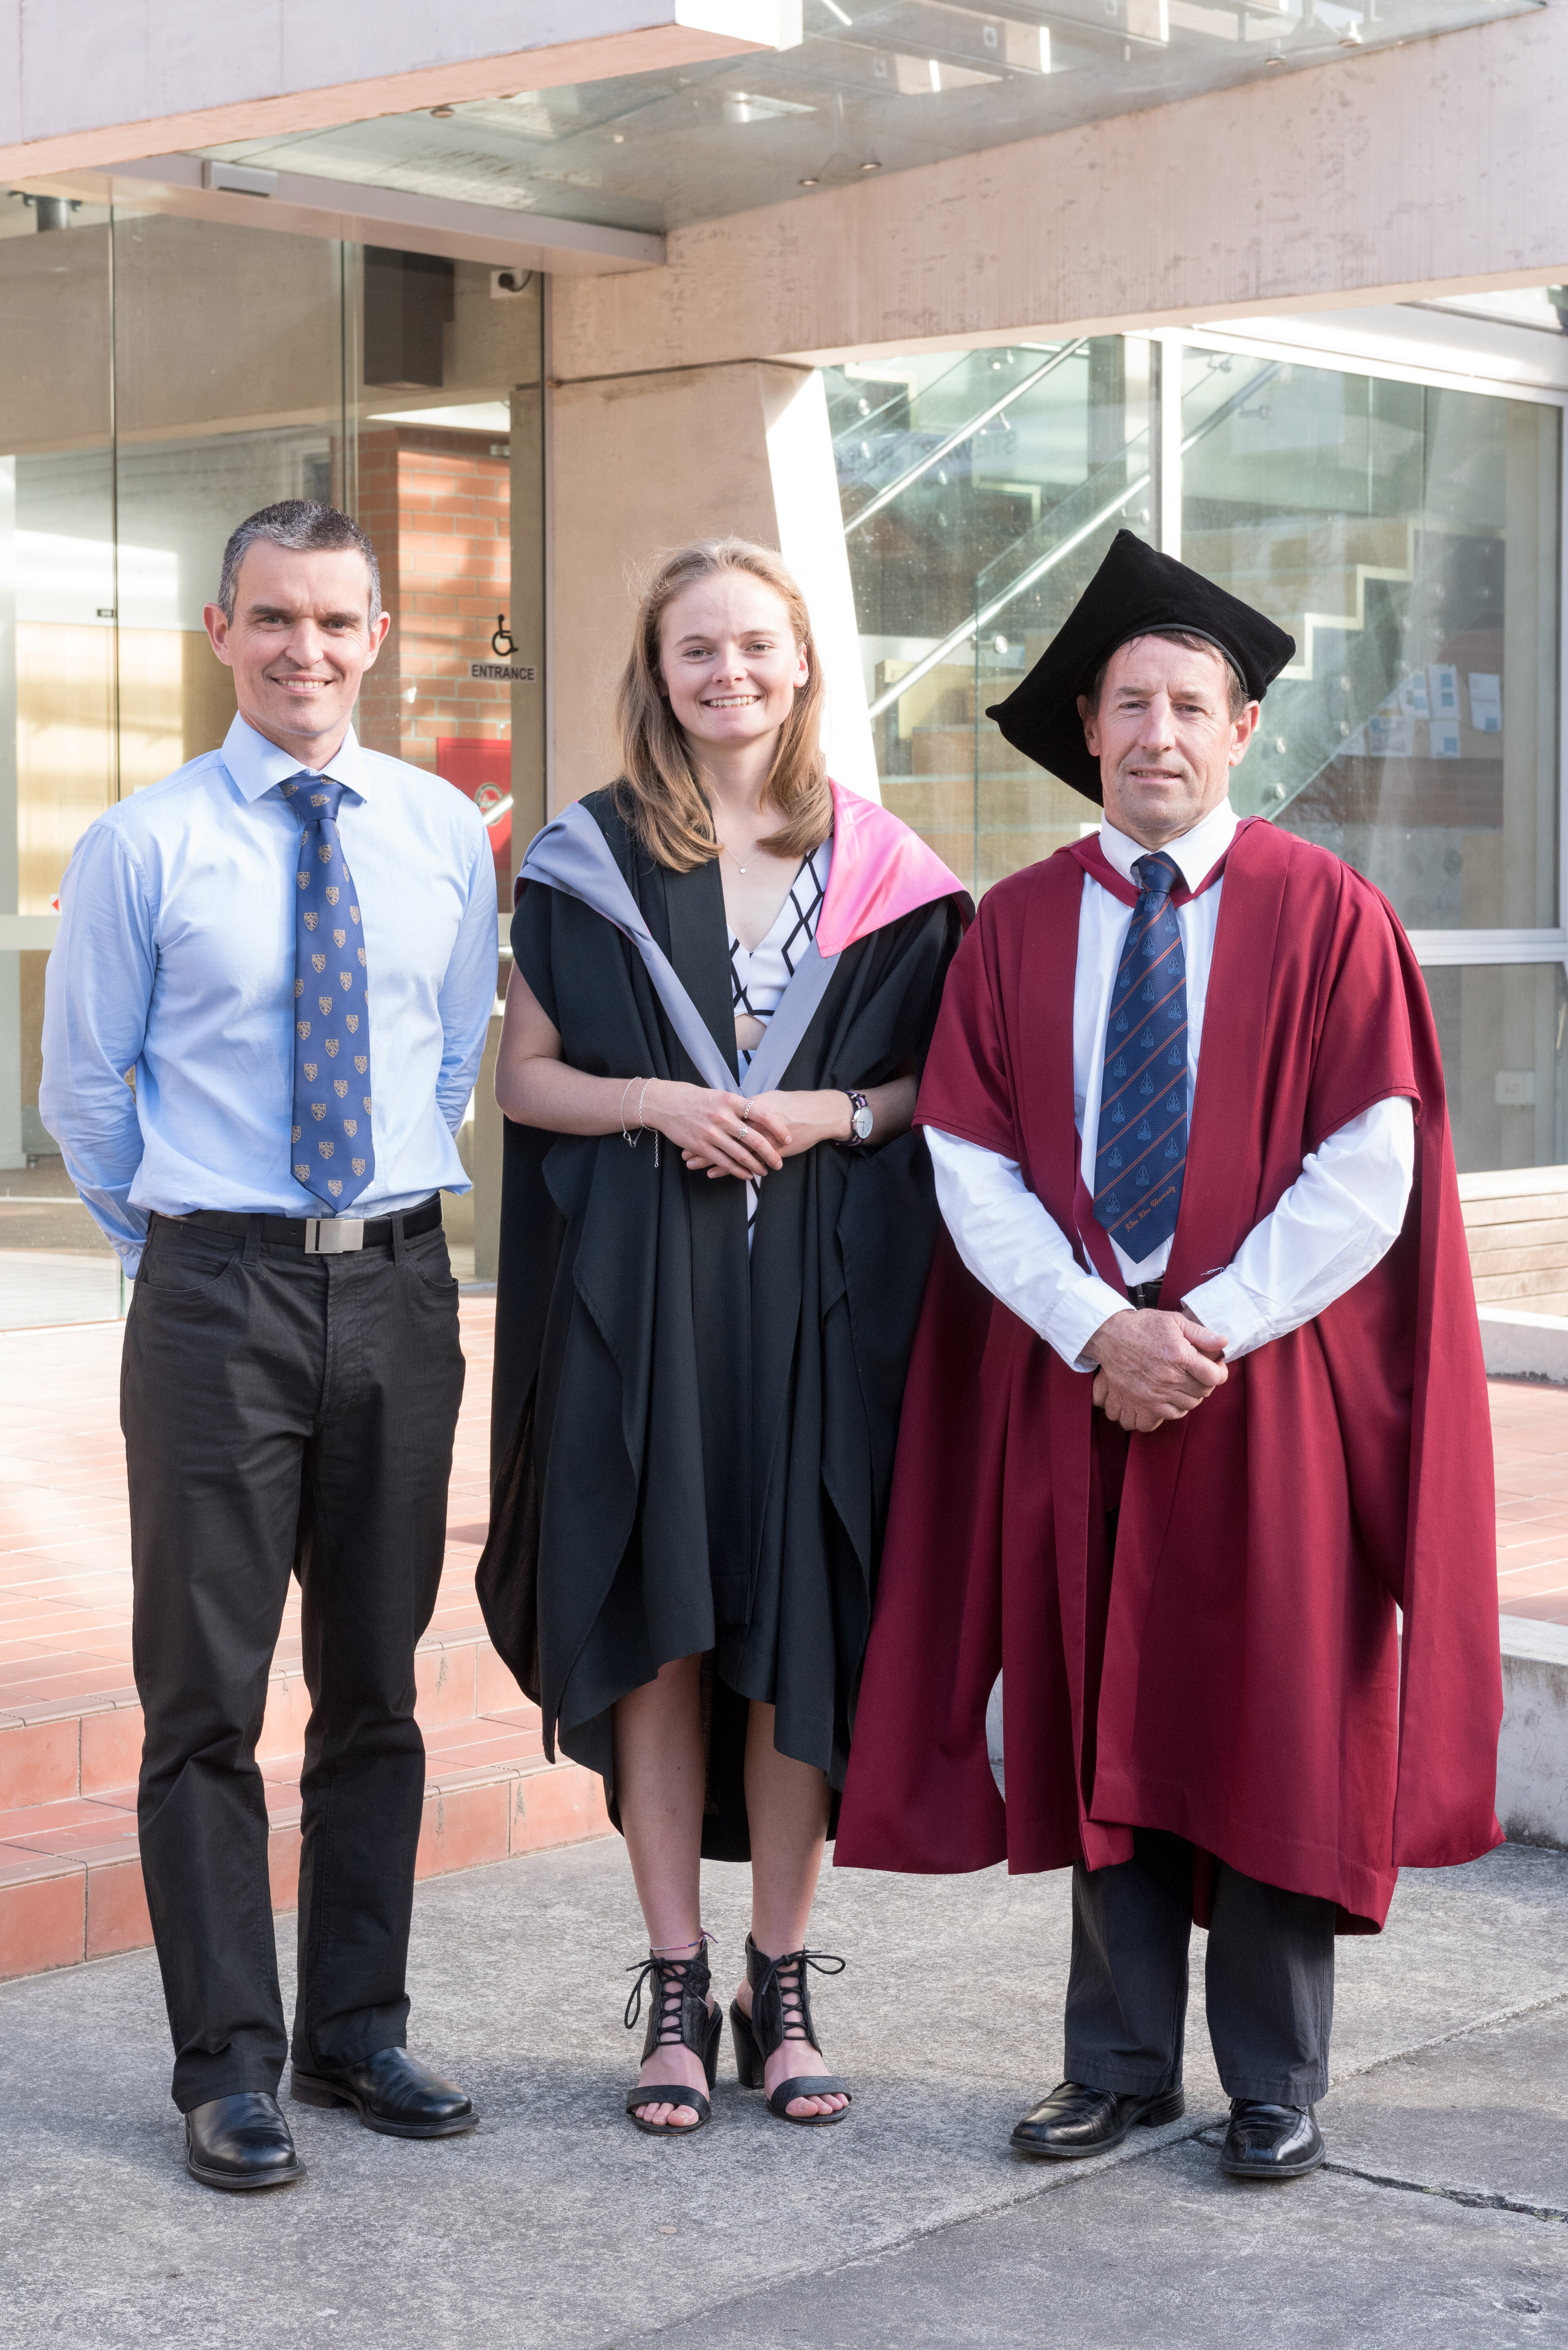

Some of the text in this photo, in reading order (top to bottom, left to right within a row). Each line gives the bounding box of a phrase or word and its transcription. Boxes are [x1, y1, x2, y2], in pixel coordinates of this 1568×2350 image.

[471, 664, 535, 680] ENTRANCE
[1125, 1220, 1139, 1232] Khon
[1151, 1186, 1176, 1207] University
